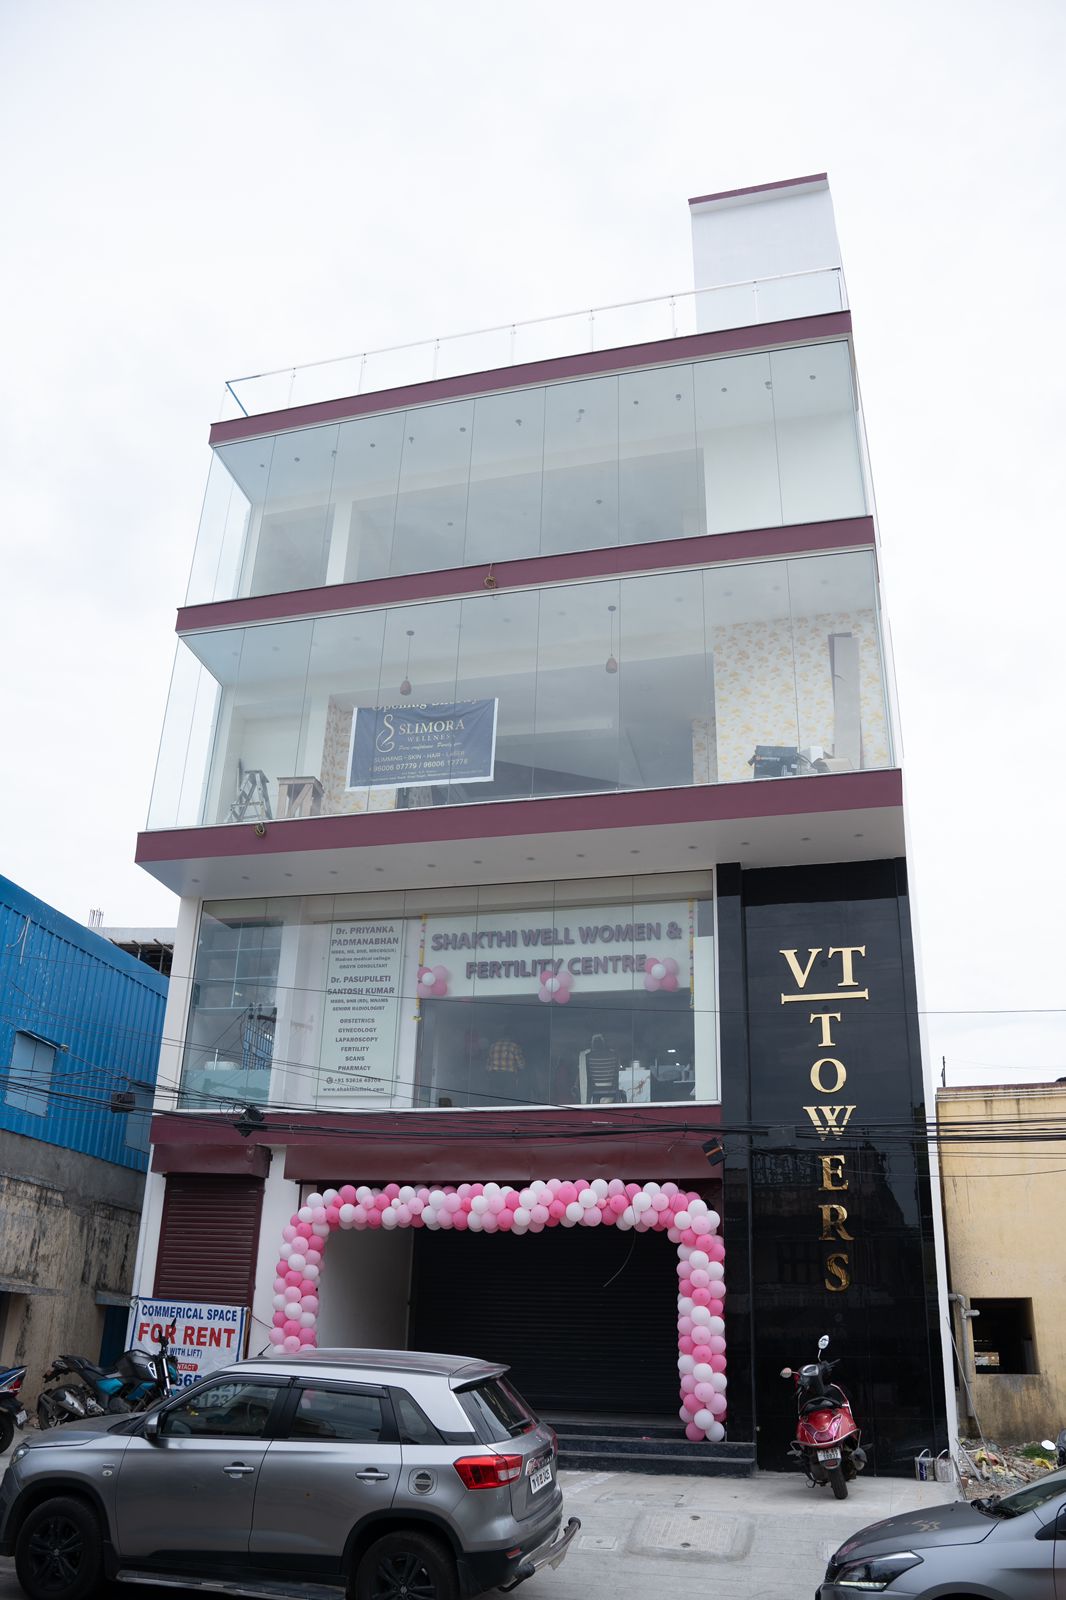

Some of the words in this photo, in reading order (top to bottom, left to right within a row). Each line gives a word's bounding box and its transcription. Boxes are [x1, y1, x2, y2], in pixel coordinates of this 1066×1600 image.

[399, 719, 465, 735] SLIMORA
[336, 927, 348, 935] Dr.
[350, 926, 394, 935] PRIYANKA
[431, 930, 518, 951] SHAKTHI
[521, 927, 575, 946] WELL
[578, 922, 662, 945] WOMEN
[666, 921, 682, 940] &
[331, 937, 399, 946] PADMANABHAN
[466, 958, 564, 979] FERTILITY
[567, 954, 648, 976] CENTRE
[779, 945, 867, 988] VT
[343, 975, 391, 983] PASUPULETI
[327, 988, 364, 996] SANTOSH
[365, 986, 395, 994] KUMAR
[802, 1012, 857, 1292] TOWERS
[141, 1304, 204, 1320] COMMERICAL
[206, 1308, 238, 1322] SPACE
[137, 1322, 177, 1345] FOR
[182, 1325, 236, 1348] RENT
